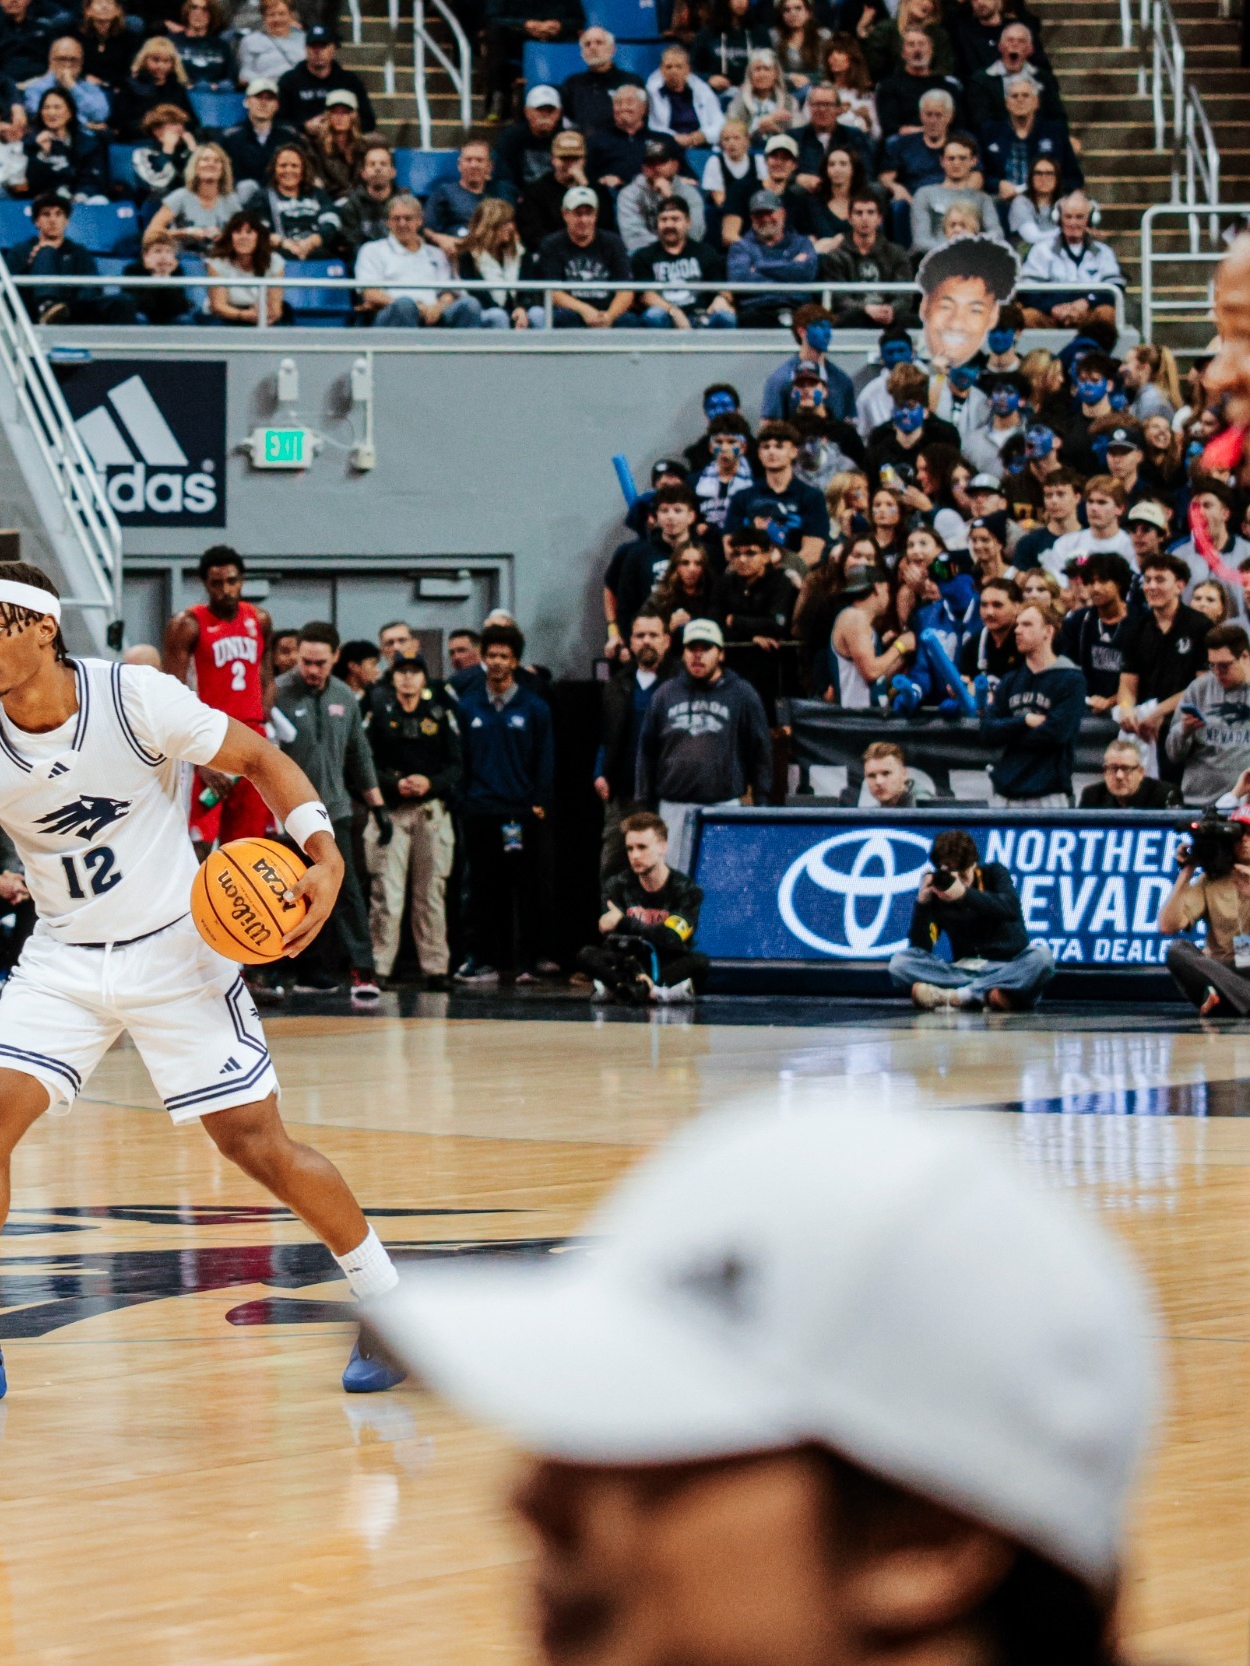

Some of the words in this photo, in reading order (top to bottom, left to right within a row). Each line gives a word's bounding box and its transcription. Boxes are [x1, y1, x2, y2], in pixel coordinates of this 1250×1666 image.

[266, 431, 303, 461] EXIT
[212, 636, 258, 668] UNLV
[231, 661, 247, 691] 2
[60, 845, 123, 899] 12
[984, 829, 1194, 873] NORTHER
[218, 868, 272, 947] Wilson
[252, 857, 297, 913] NCAA
[1012, 876, 1180, 933] EVAD
